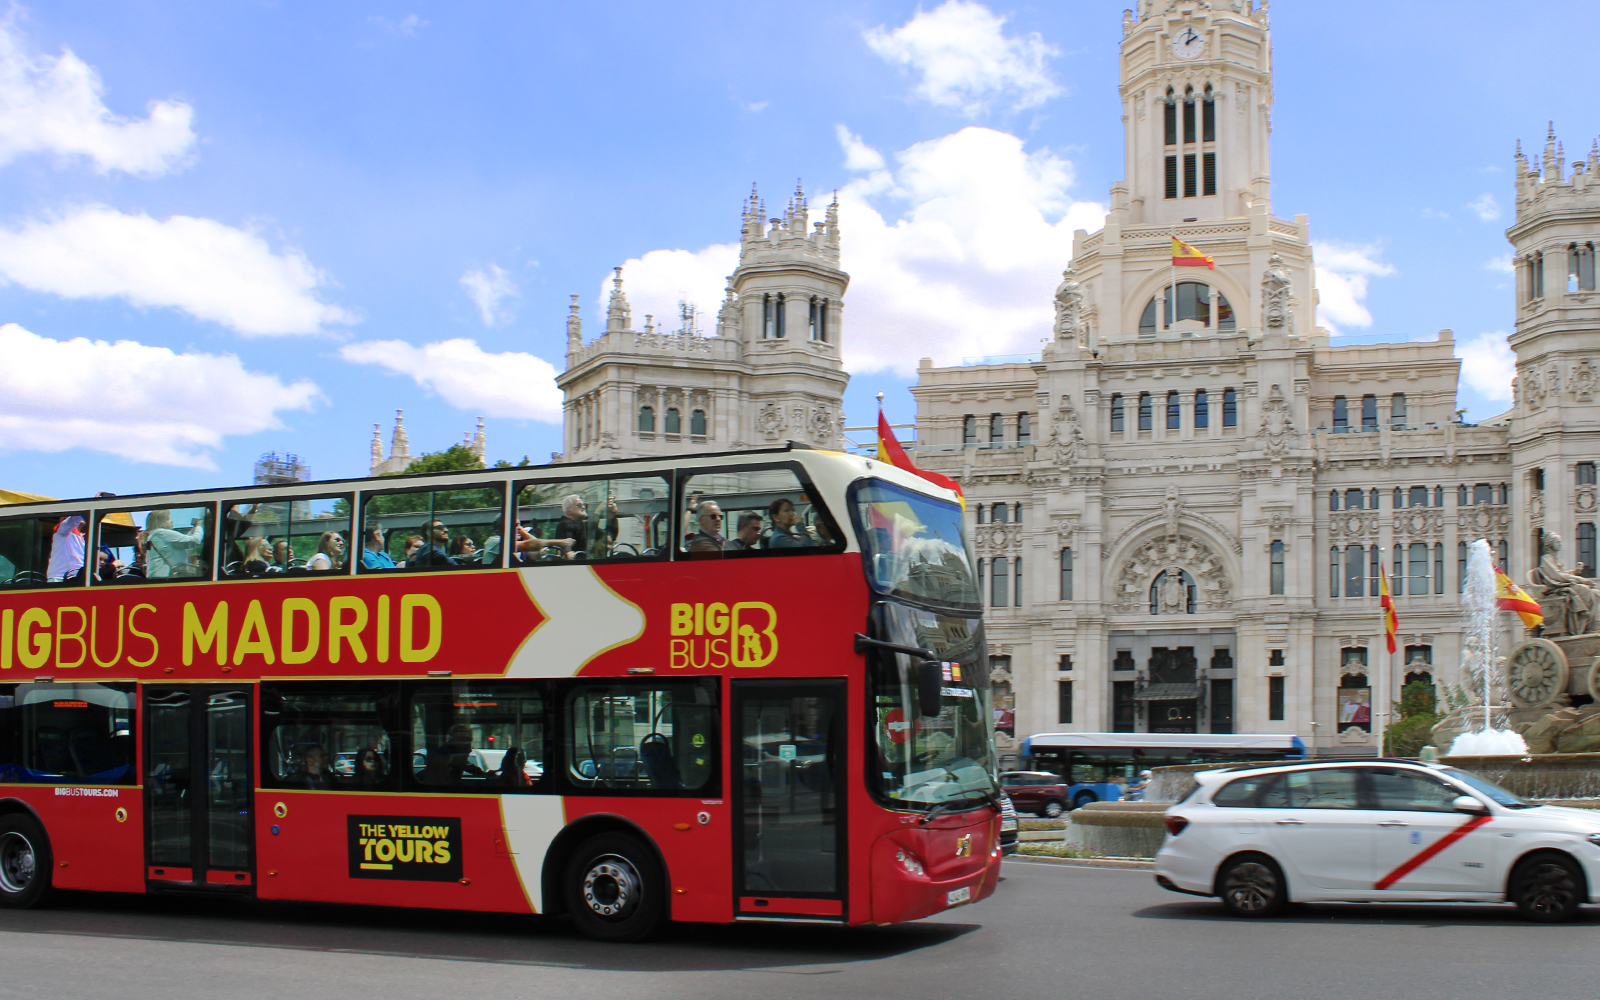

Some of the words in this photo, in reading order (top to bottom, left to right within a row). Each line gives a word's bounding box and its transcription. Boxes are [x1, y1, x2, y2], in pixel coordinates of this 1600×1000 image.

[182, 594, 442, 666] MADRID
[670, 602, 730, 636] BIG
[670, 638, 730, 669] BUS
[54, 787, 119, 797] BIGBUSTOURS.COM
[359, 824, 386, 837] THE
[388, 824, 449, 839] YELLOW
[359, 838, 451, 864] TOURS
